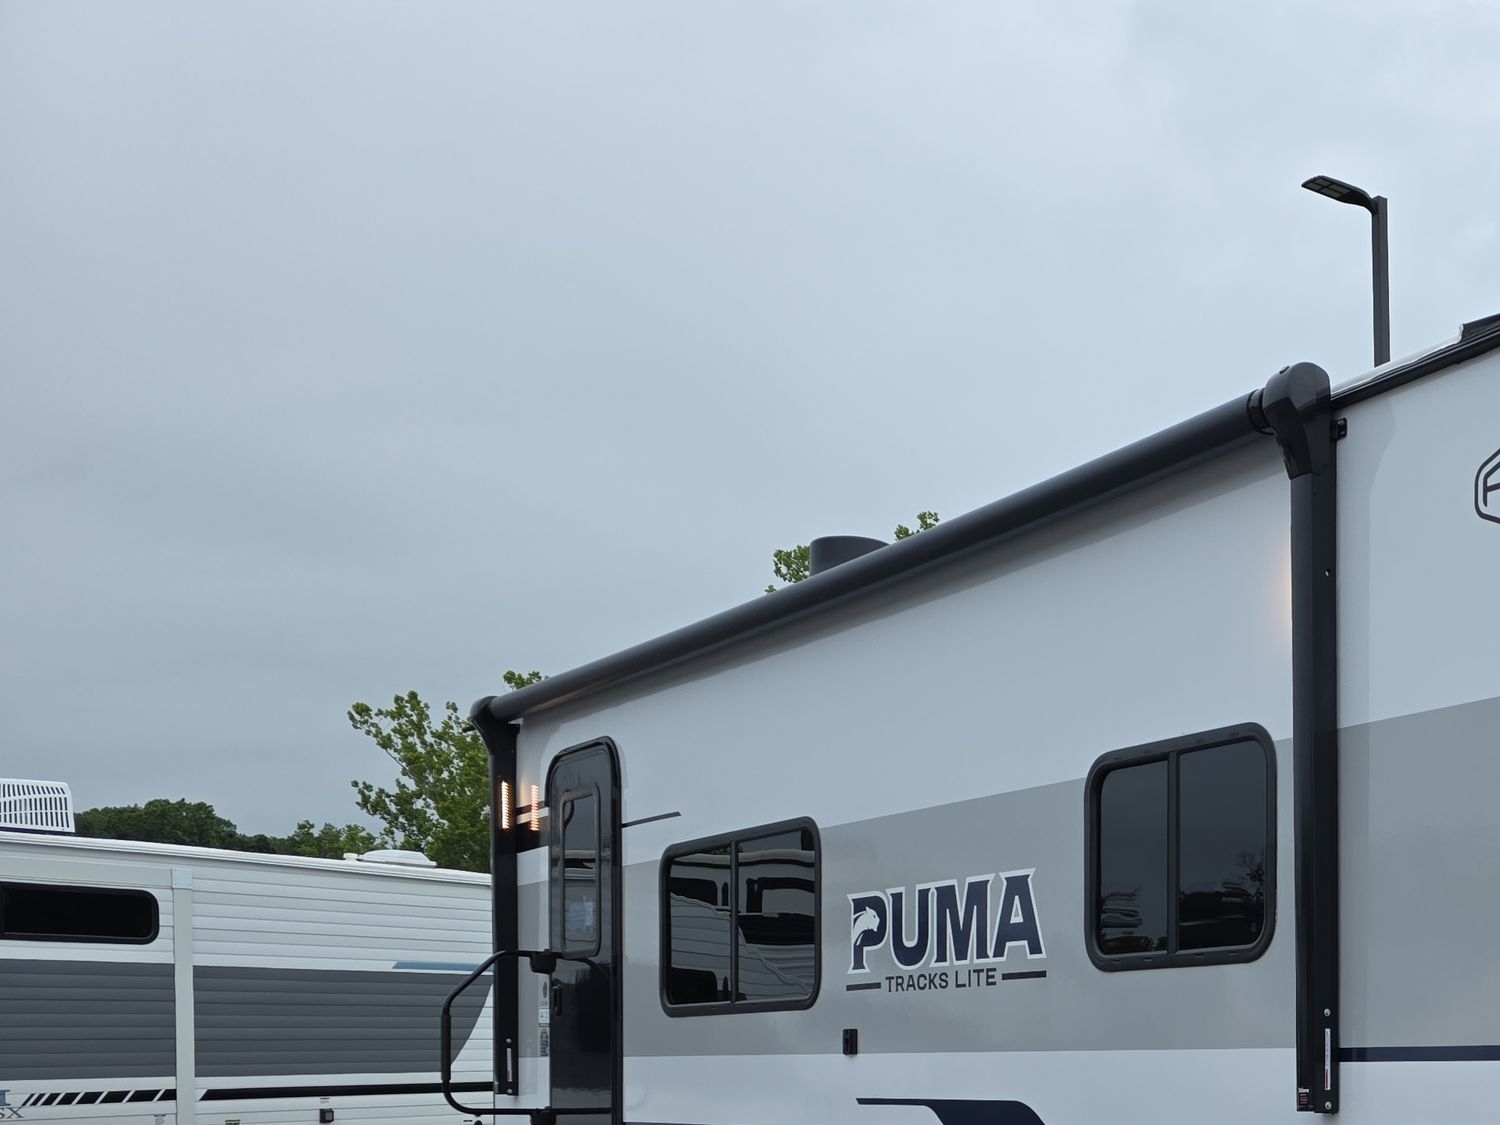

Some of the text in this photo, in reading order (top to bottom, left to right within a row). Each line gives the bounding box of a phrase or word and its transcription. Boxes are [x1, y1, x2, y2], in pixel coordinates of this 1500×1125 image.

[847, 868, 1046, 974] PUMA
[885, 968, 997, 992] TRACKS LITE
